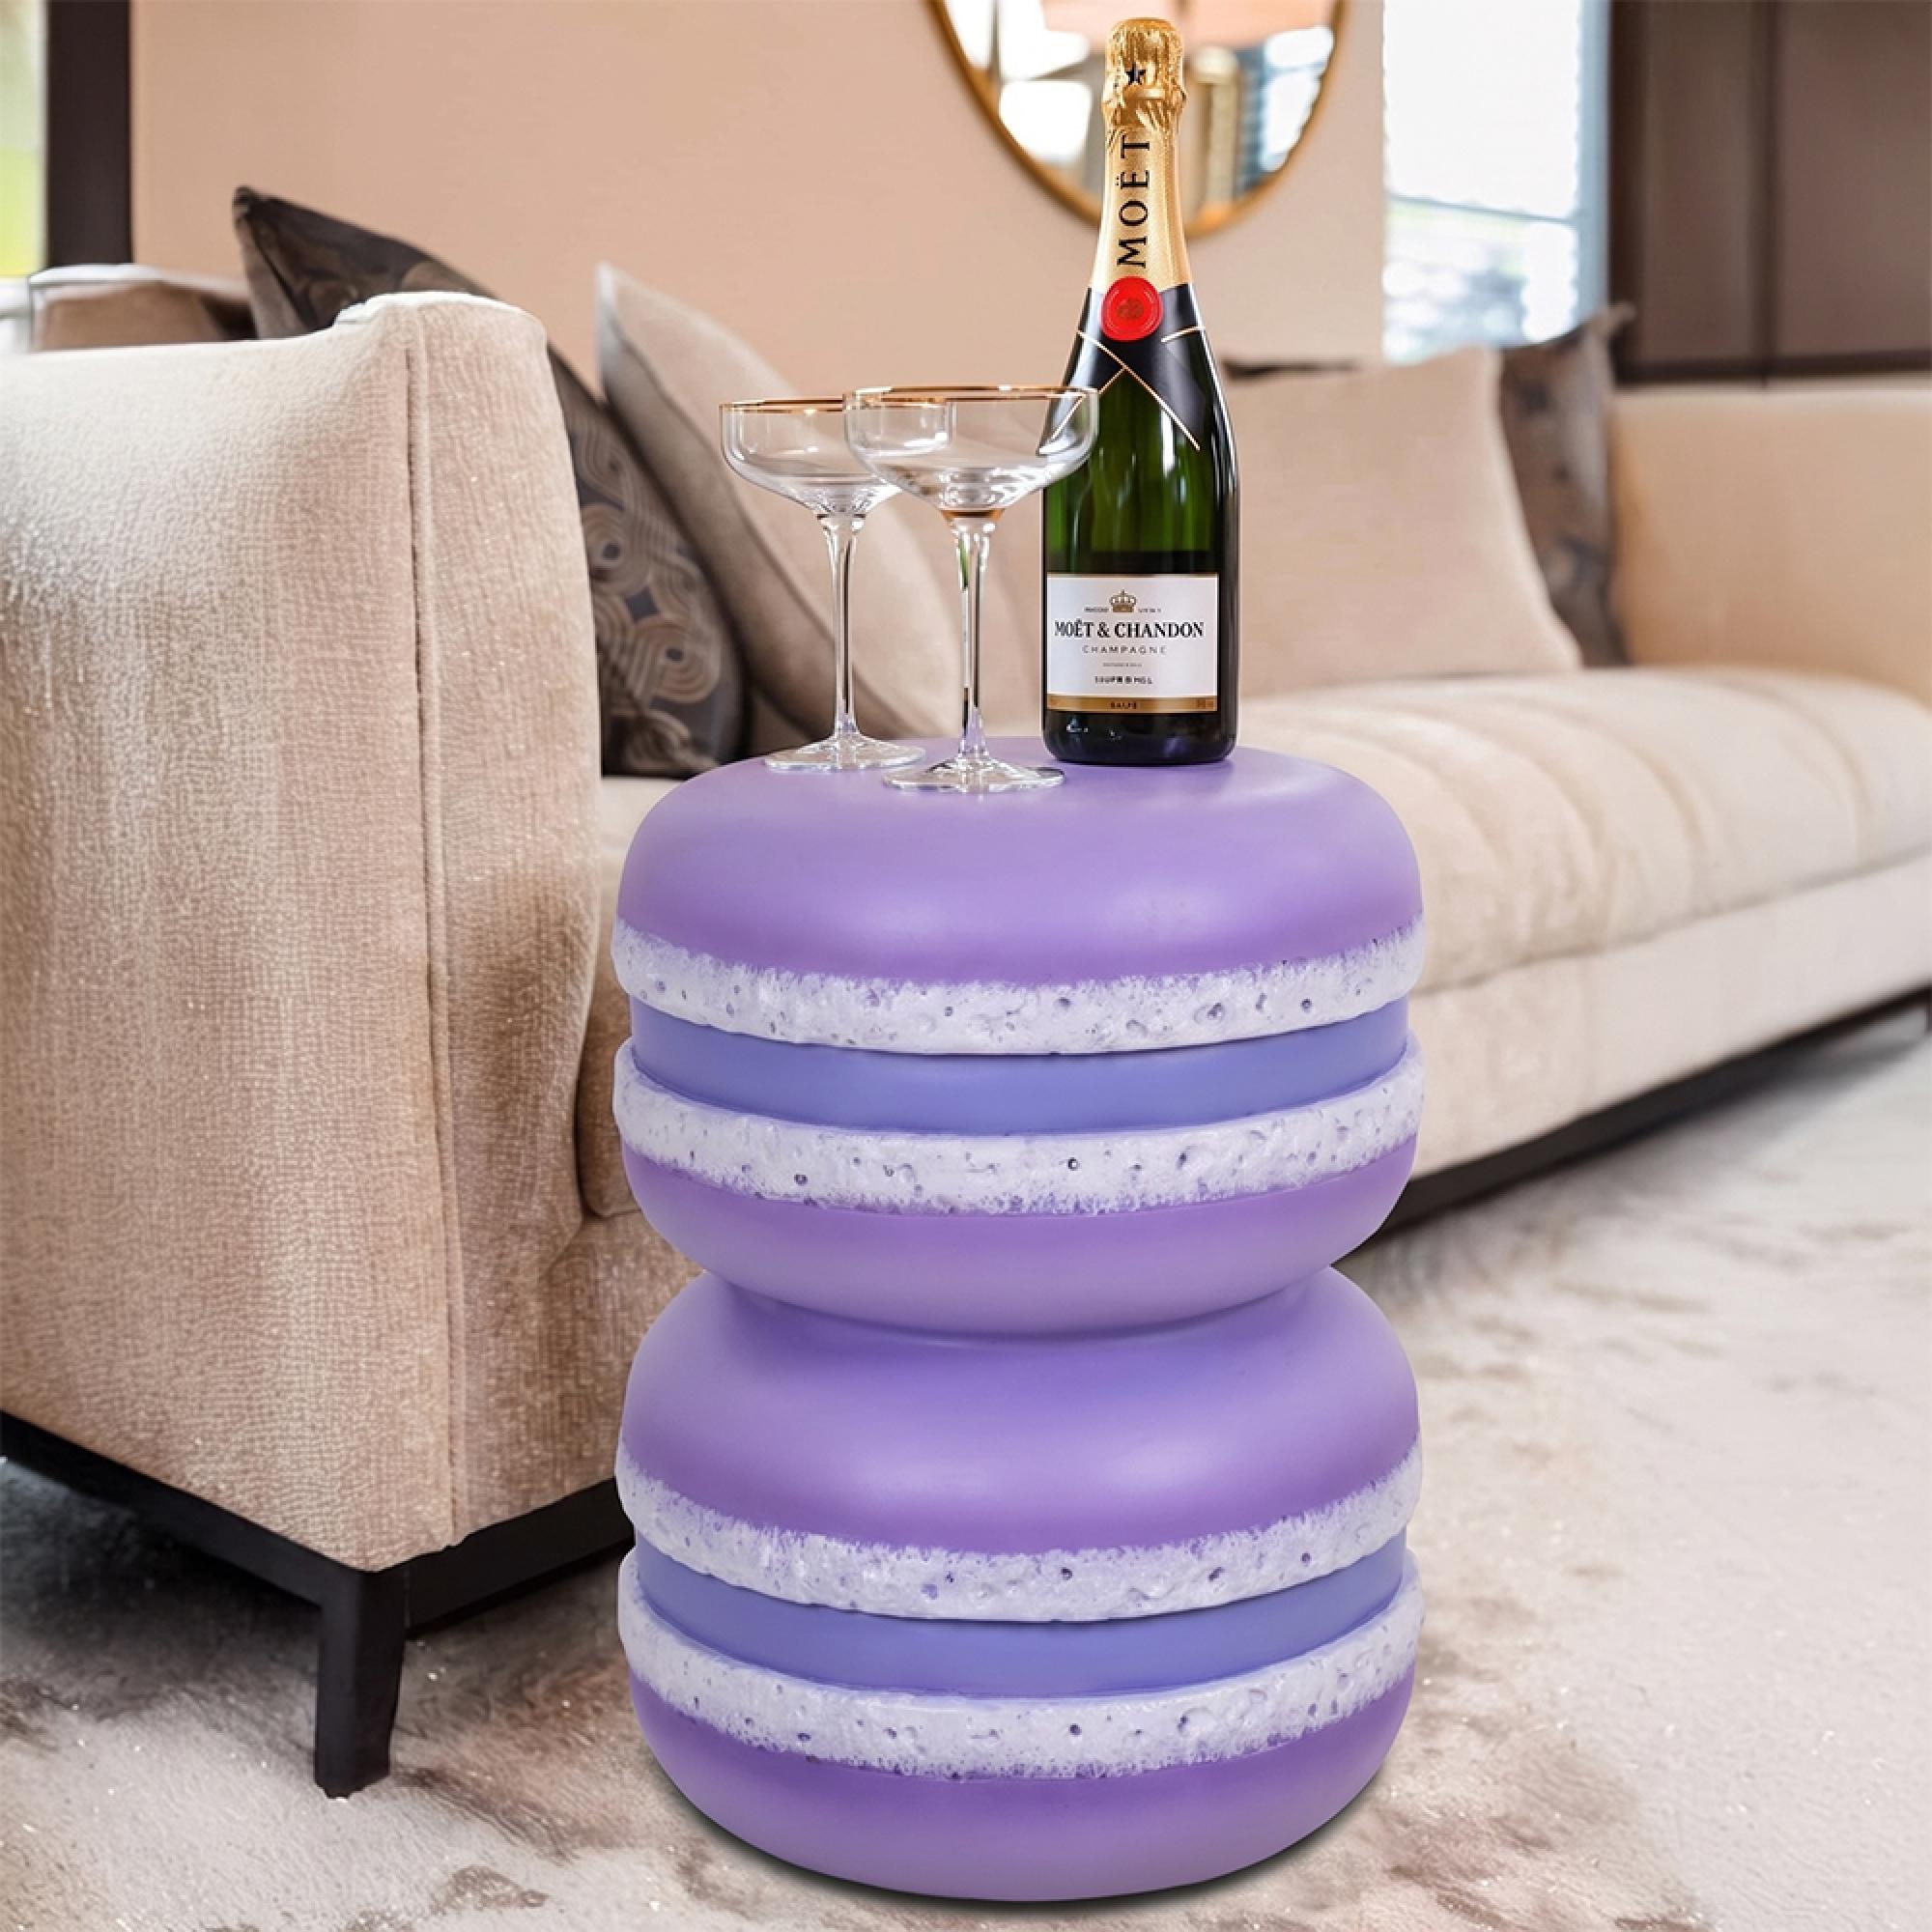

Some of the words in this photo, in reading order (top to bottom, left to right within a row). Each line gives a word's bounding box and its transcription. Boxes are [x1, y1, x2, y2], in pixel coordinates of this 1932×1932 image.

[1116, 134, 1151, 269] MOËT
[1054, 618, 1094, 639] MOËT
[1097, 621, 1111, 639] &
[1114, 621, 1205, 639] CHANDON
[1082, 645, 1168, 655] CHAMPAGNE
